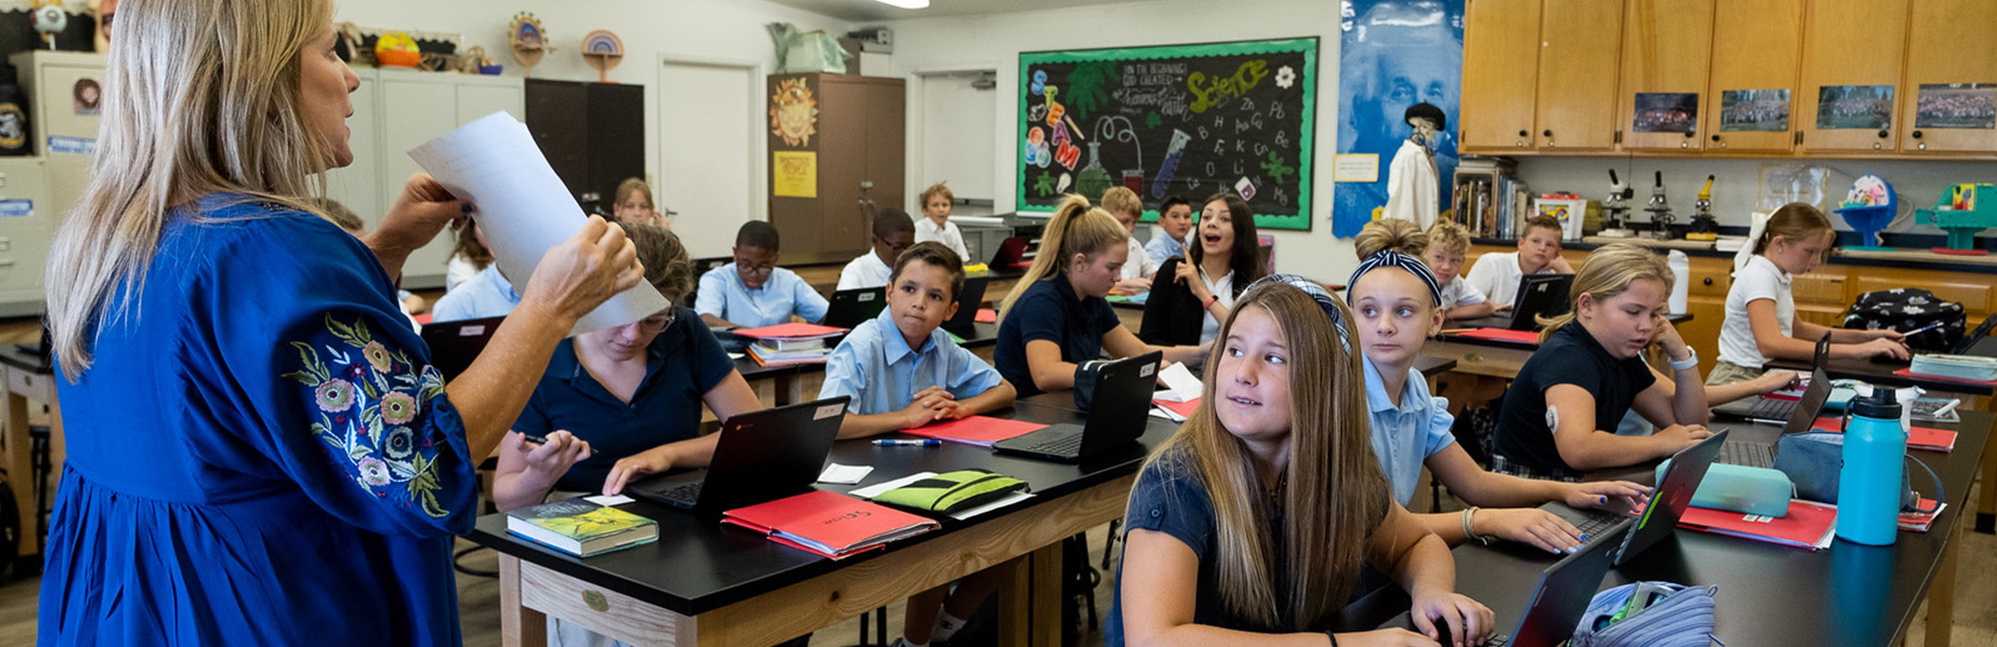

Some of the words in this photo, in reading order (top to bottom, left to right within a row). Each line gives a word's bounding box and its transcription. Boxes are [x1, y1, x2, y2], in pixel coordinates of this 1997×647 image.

[1031, 69, 1081, 171] STEAM
[1214, 115, 1224, 128] H
[1236, 138, 1245, 152] K
